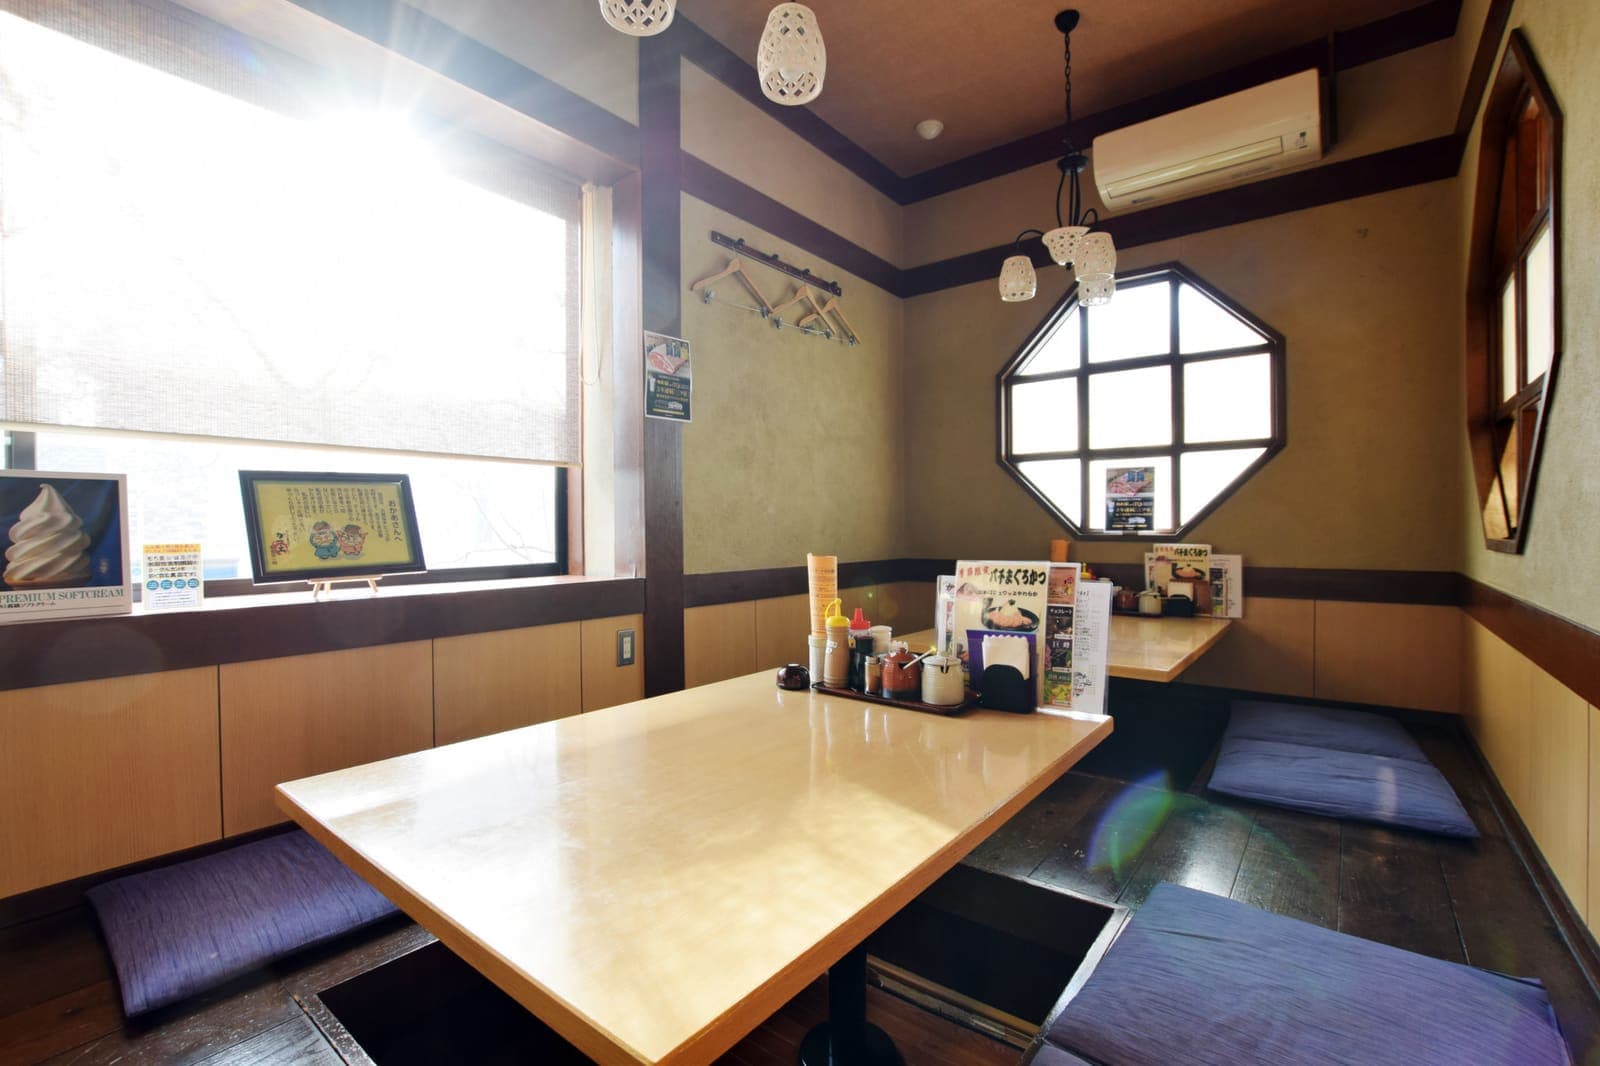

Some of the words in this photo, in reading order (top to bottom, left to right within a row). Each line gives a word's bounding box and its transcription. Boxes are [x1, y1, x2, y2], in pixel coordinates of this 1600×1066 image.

[990, 568, 1047, 585] バチまぐろかつ
[0, 592, 56, 603] PREMIUM
[57, 588, 124, 600] SOFTCREAM
